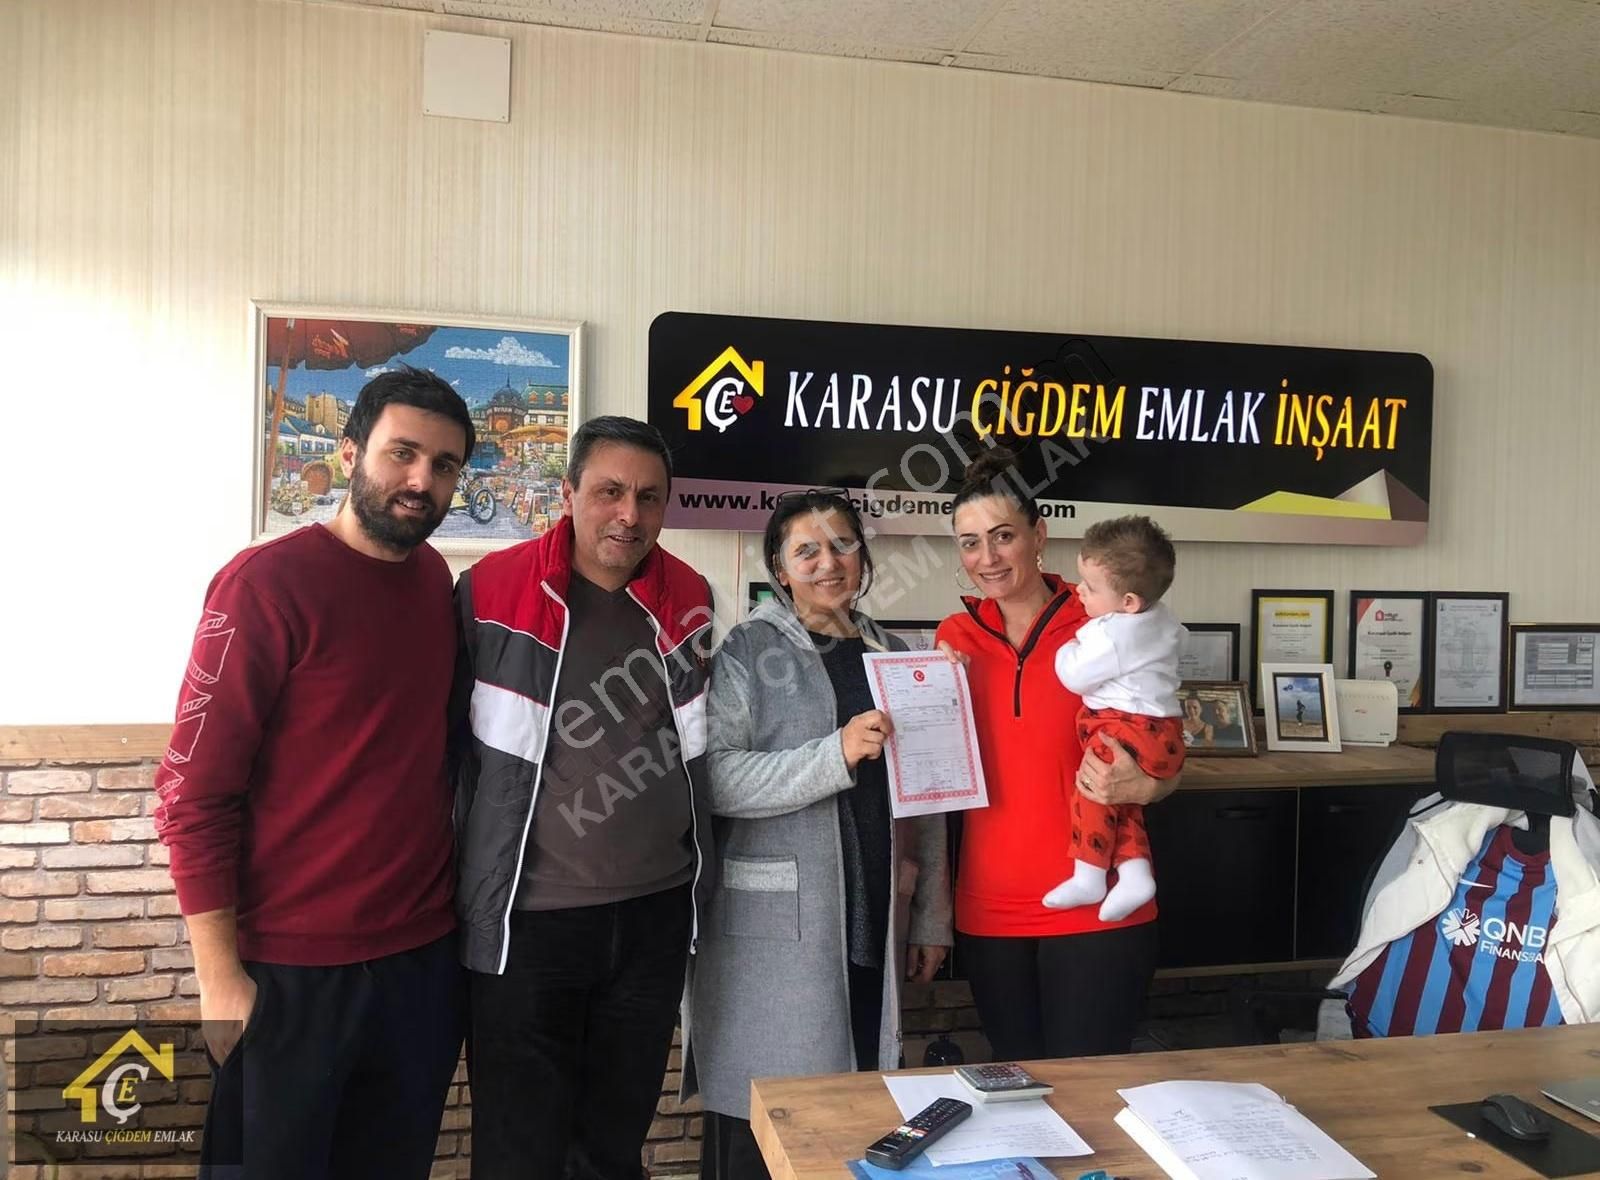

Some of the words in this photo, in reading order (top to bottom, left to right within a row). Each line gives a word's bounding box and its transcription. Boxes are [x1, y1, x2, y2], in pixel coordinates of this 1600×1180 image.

[783, 370, 961, 434] KARASU
[970, 364, 1127, 441] ÇİĞDEM
[1134, 385, 1266, 445] EMLAK
[1273, 378, 1407, 462] İNŞAAT
[1483, 917, 1547, 948] QNB
